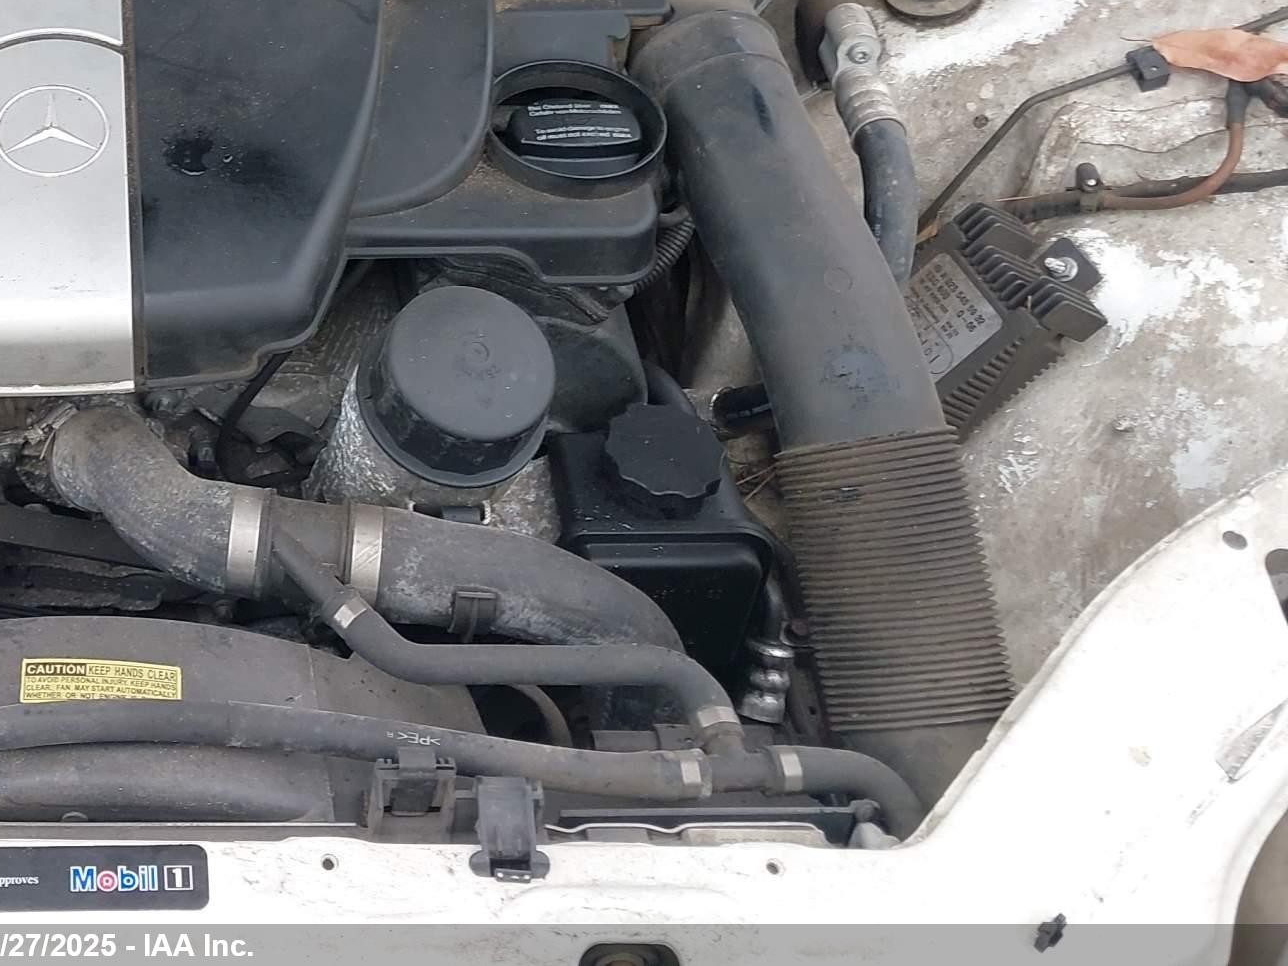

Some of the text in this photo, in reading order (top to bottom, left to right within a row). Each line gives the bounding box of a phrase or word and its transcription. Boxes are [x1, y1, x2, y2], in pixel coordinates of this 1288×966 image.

[26, 664, 85, 675] CAUTION
[88, 666, 111, 676] KEEP
[115, 667, 144, 679] HANDS
[91, 685, 116, 693] START
[116, 686, 177, 698] AUTOMATICALLY
[130, 680, 150, 688] KEEP
[150, 682, 177, 691] HANDS
[25, 691, 62, 699] WHETHER
[70, 865, 159, 892] Mobil
